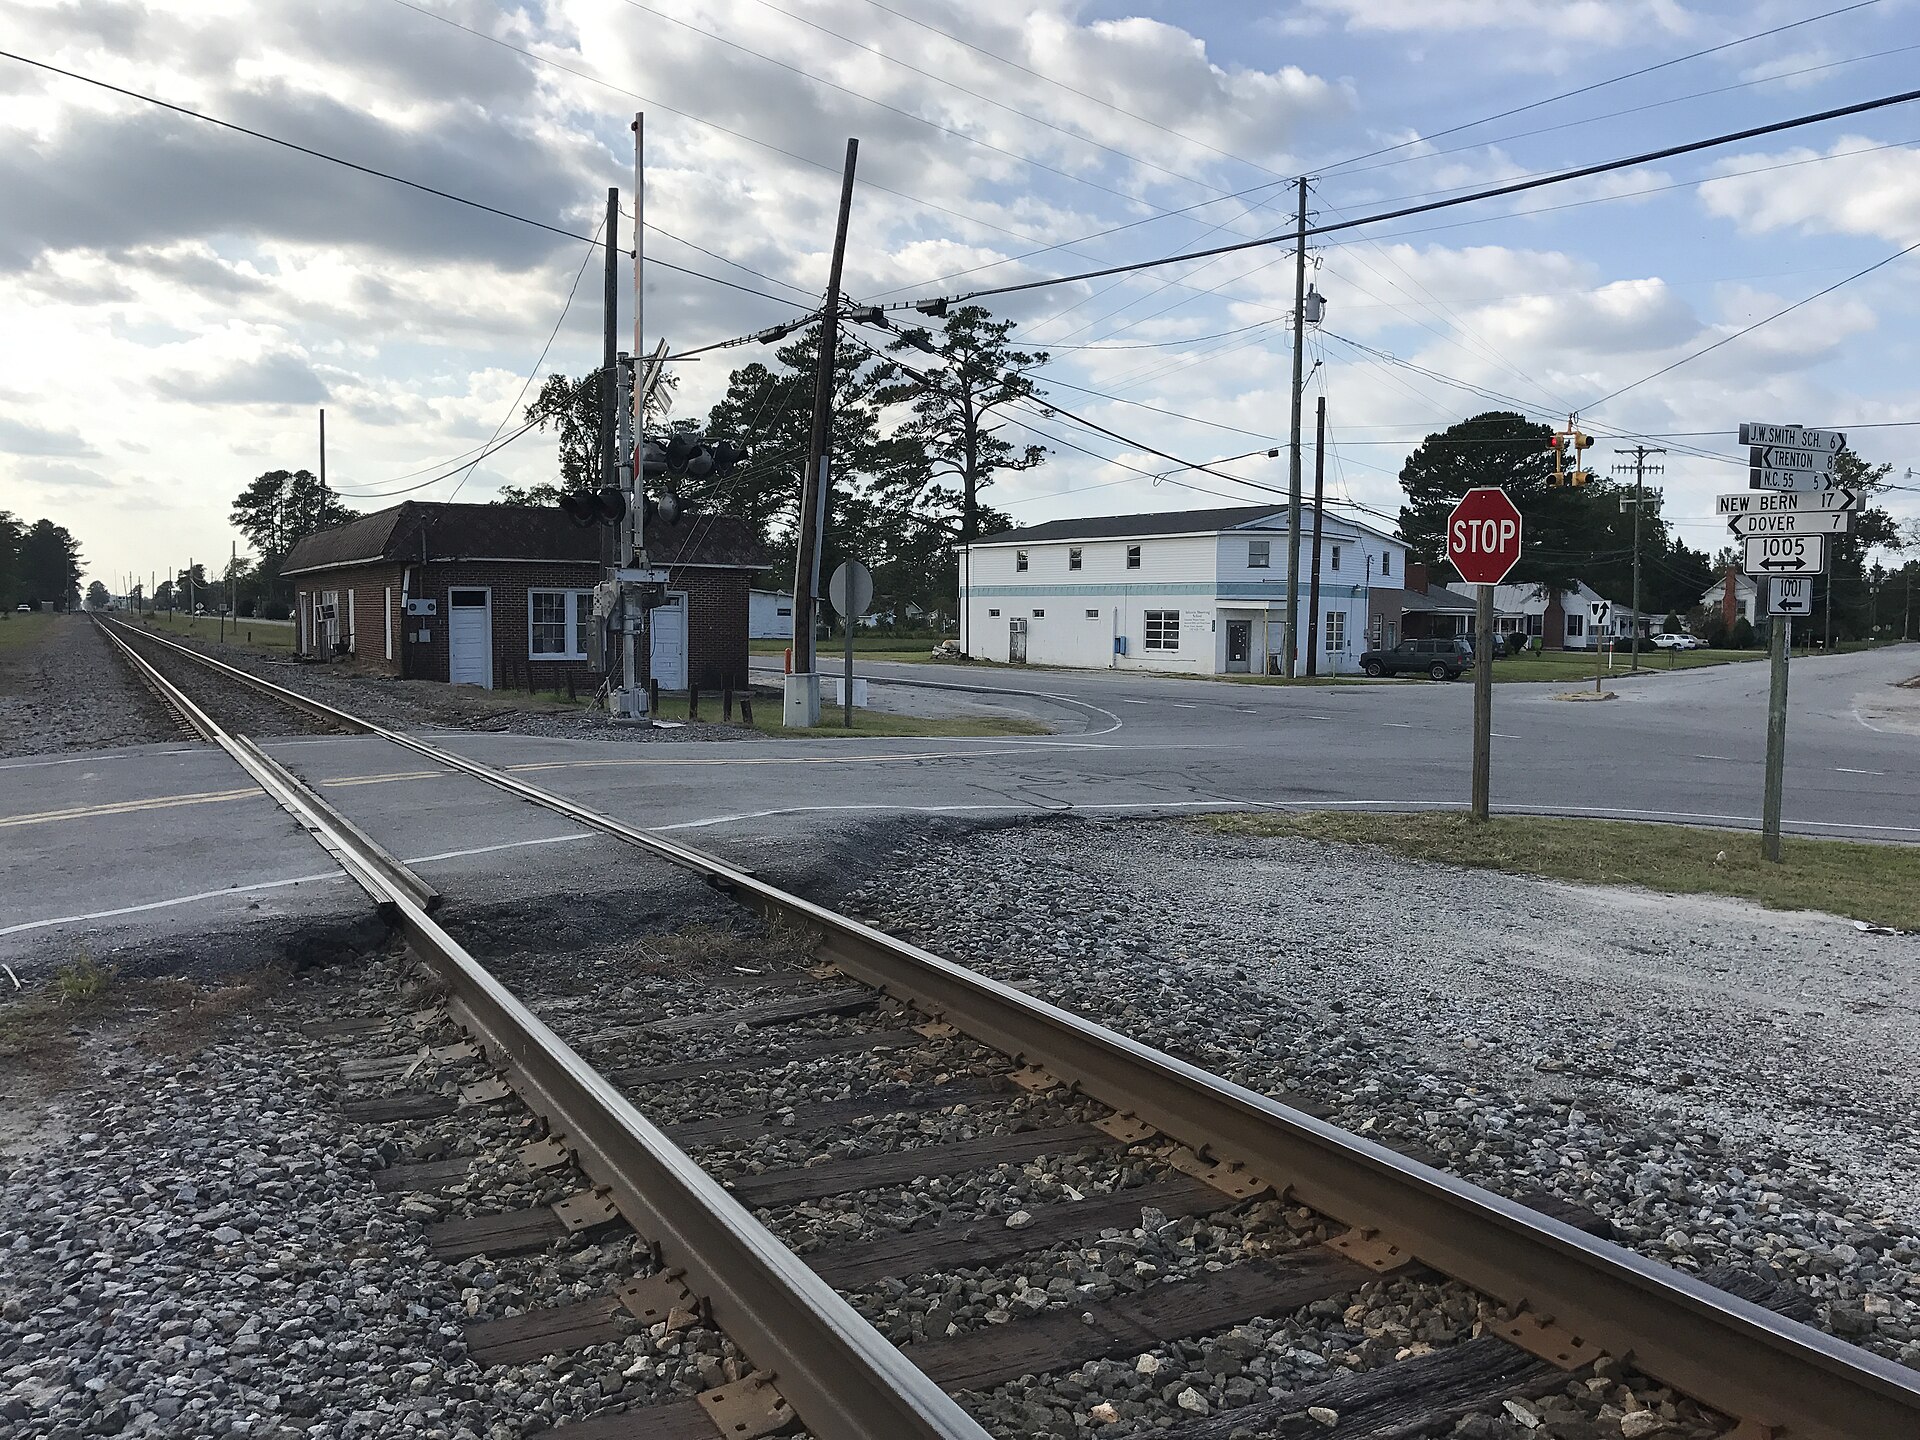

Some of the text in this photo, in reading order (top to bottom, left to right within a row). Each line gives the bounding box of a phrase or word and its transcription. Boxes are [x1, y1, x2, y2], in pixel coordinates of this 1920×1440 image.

[1802, 432, 1821, 448] SCH.
[1830, 436, 1836, 449] 6
[1774, 450, 1833, 470] TRENTON 8
[1764, 471, 1819, 490] N.C. 55 5
[1720, 492, 1835, 512] NEW BERN 17
[1749, 515, 1840, 532] DOVER 7
[1452, 519, 1516, 553] STOP
[1762, 538, 1805, 556] 1005
[1780, 580, 1801, 597] 1001
